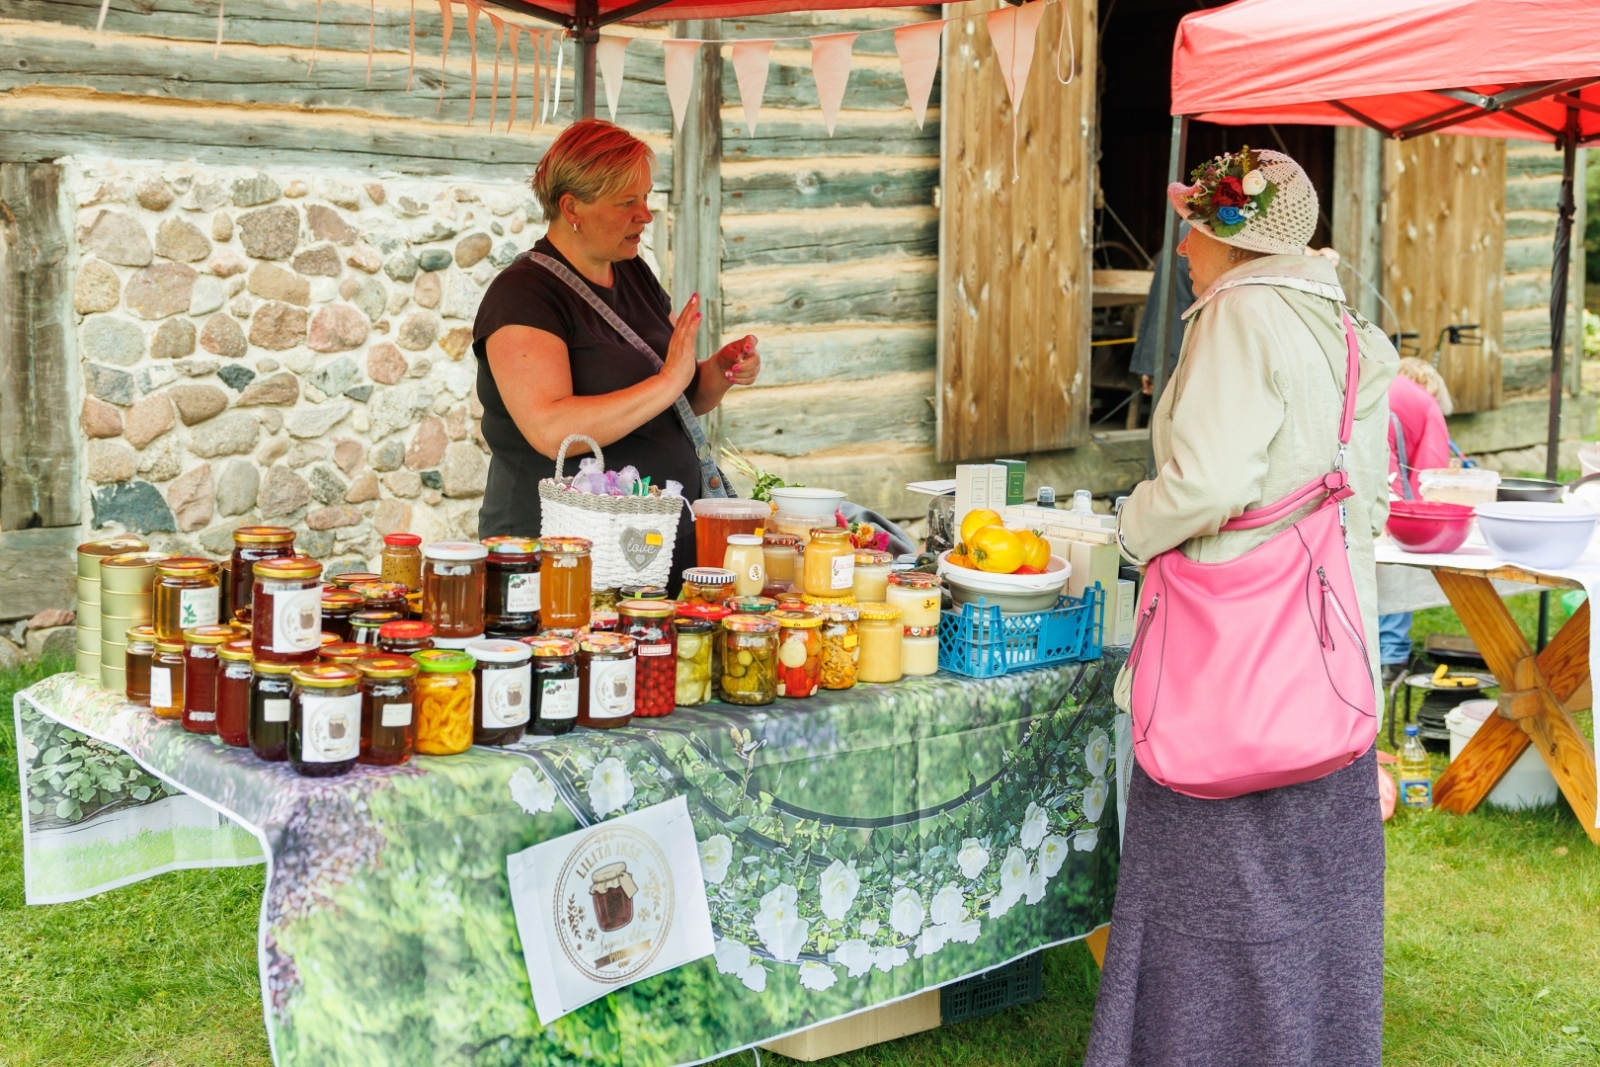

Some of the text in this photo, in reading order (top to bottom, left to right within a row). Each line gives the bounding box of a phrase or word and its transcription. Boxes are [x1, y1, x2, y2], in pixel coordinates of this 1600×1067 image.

[626, 537, 656, 554] love
[576, 841, 643, 879] LILITA IKŠE
